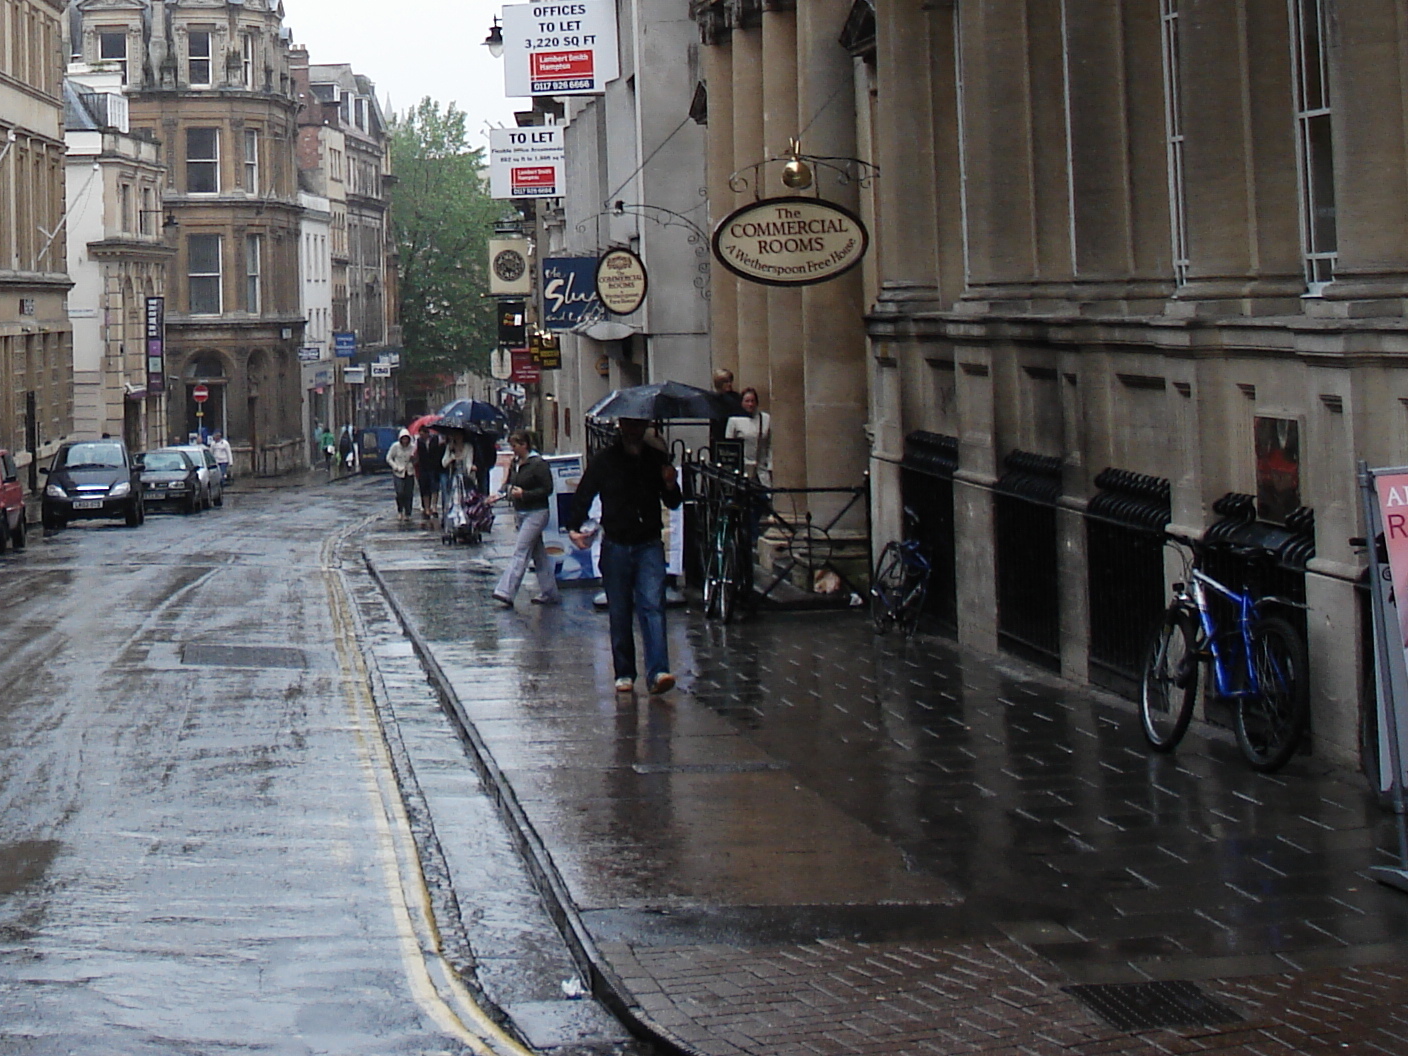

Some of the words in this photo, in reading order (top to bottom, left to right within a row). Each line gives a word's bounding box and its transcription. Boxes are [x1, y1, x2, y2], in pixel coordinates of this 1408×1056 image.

[533, 4, 586, 17] OFFICES
[538, 22, 555, 33] TO
[560, 21, 581, 32] LET
[525, 37, 559, 50] 3,220
[563, 36, 580, 47] SQ
[583, 35, 596, 45] FT
[509, 133, 526, 144] TO
[532, 132, 554, 143] LET
[775, 208, 801, 219] The
[730, 219, 849, 238] COMMERCIAL
[757, 237, 824, 255] ROOMS
[725, 244, 738, 255] A
[735, 250, 810, 276] Wetherspoon
[806, 258, 831, 272] Free
[830, 238, 857, 264] House
[598, 275, 643, 284] COMMERCIAL
[608, 282, 635, 290] ROOMS
[545, 311, 566, 321] and
